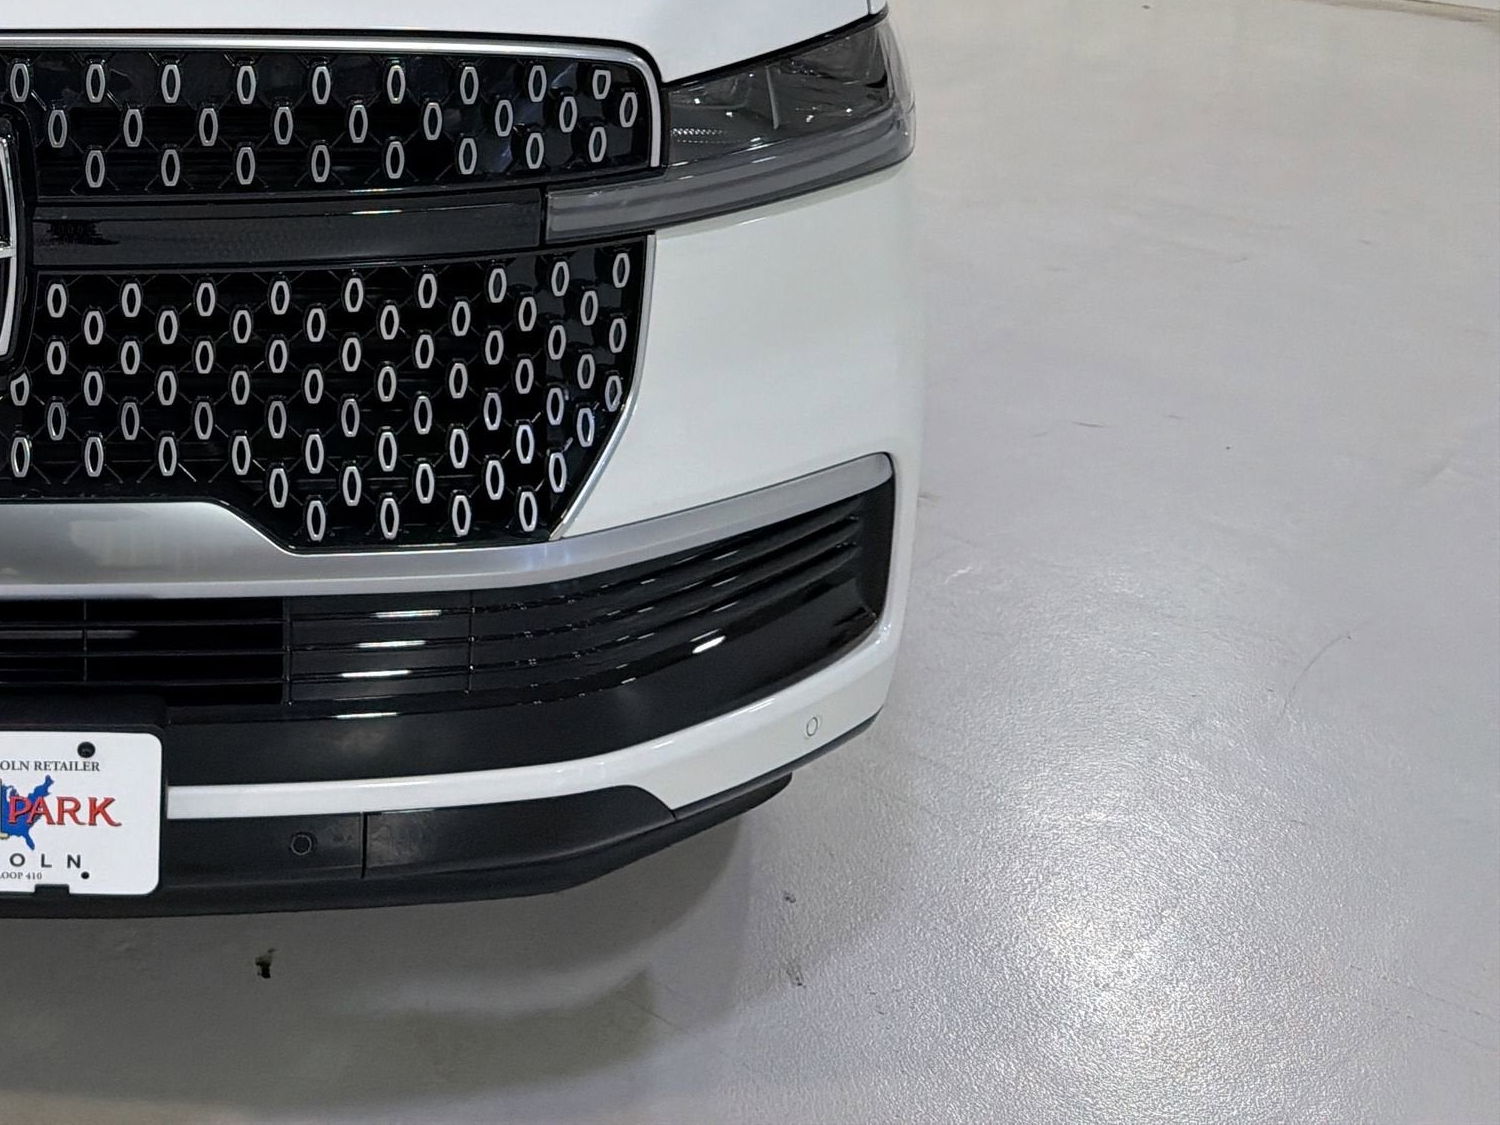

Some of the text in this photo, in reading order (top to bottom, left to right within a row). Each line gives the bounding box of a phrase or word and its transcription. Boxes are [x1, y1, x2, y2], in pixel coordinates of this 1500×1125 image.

[34, 760, 100, 772] RETAILER
[8, 795, 122, 827] PARK
[26, 871, 43, 880] 410
